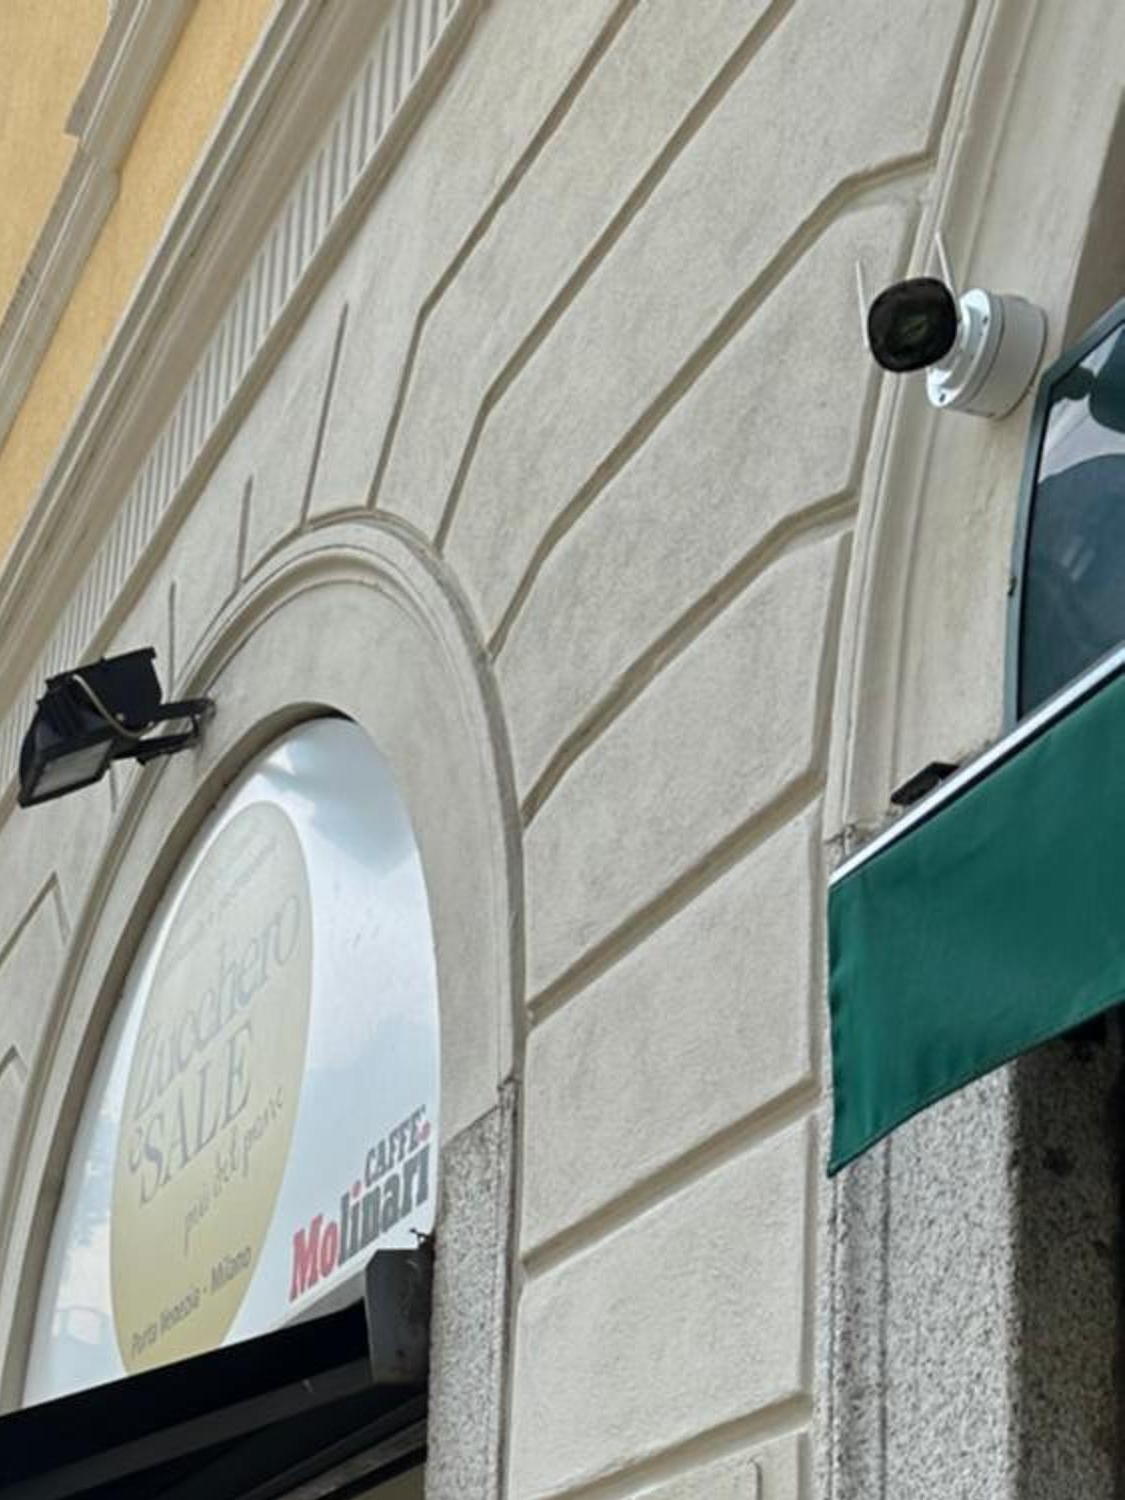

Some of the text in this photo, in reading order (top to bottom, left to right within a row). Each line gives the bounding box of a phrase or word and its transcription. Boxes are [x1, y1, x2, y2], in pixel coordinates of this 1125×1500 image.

[133, 894, 300, 1122] Zucchero
[140, 1018, 250, 1207] SALE
[289, 1122, 430, 1303] Molinari
